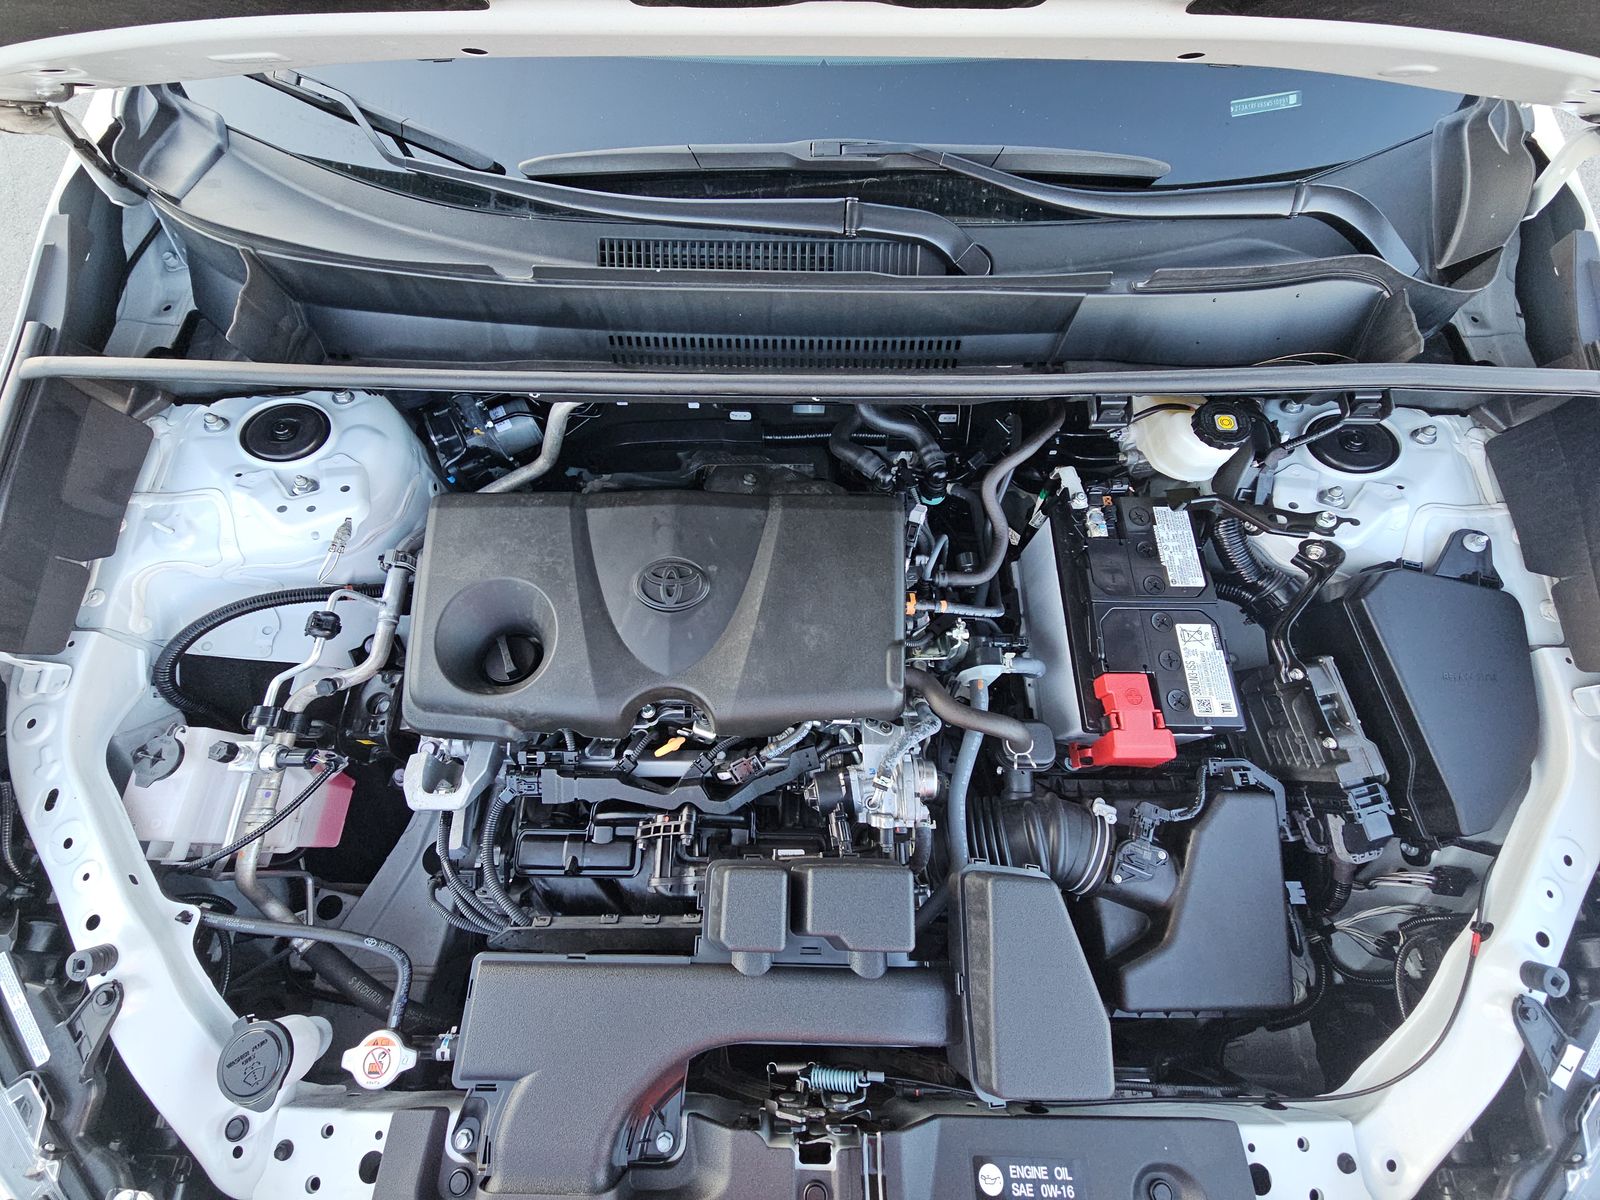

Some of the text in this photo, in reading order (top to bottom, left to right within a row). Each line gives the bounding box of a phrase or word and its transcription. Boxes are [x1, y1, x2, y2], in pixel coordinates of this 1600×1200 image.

[1009, 1165, 1073, 1181] ENGINE OIL
[1011, 1183, 1075, 1199] SAE 0W-16
